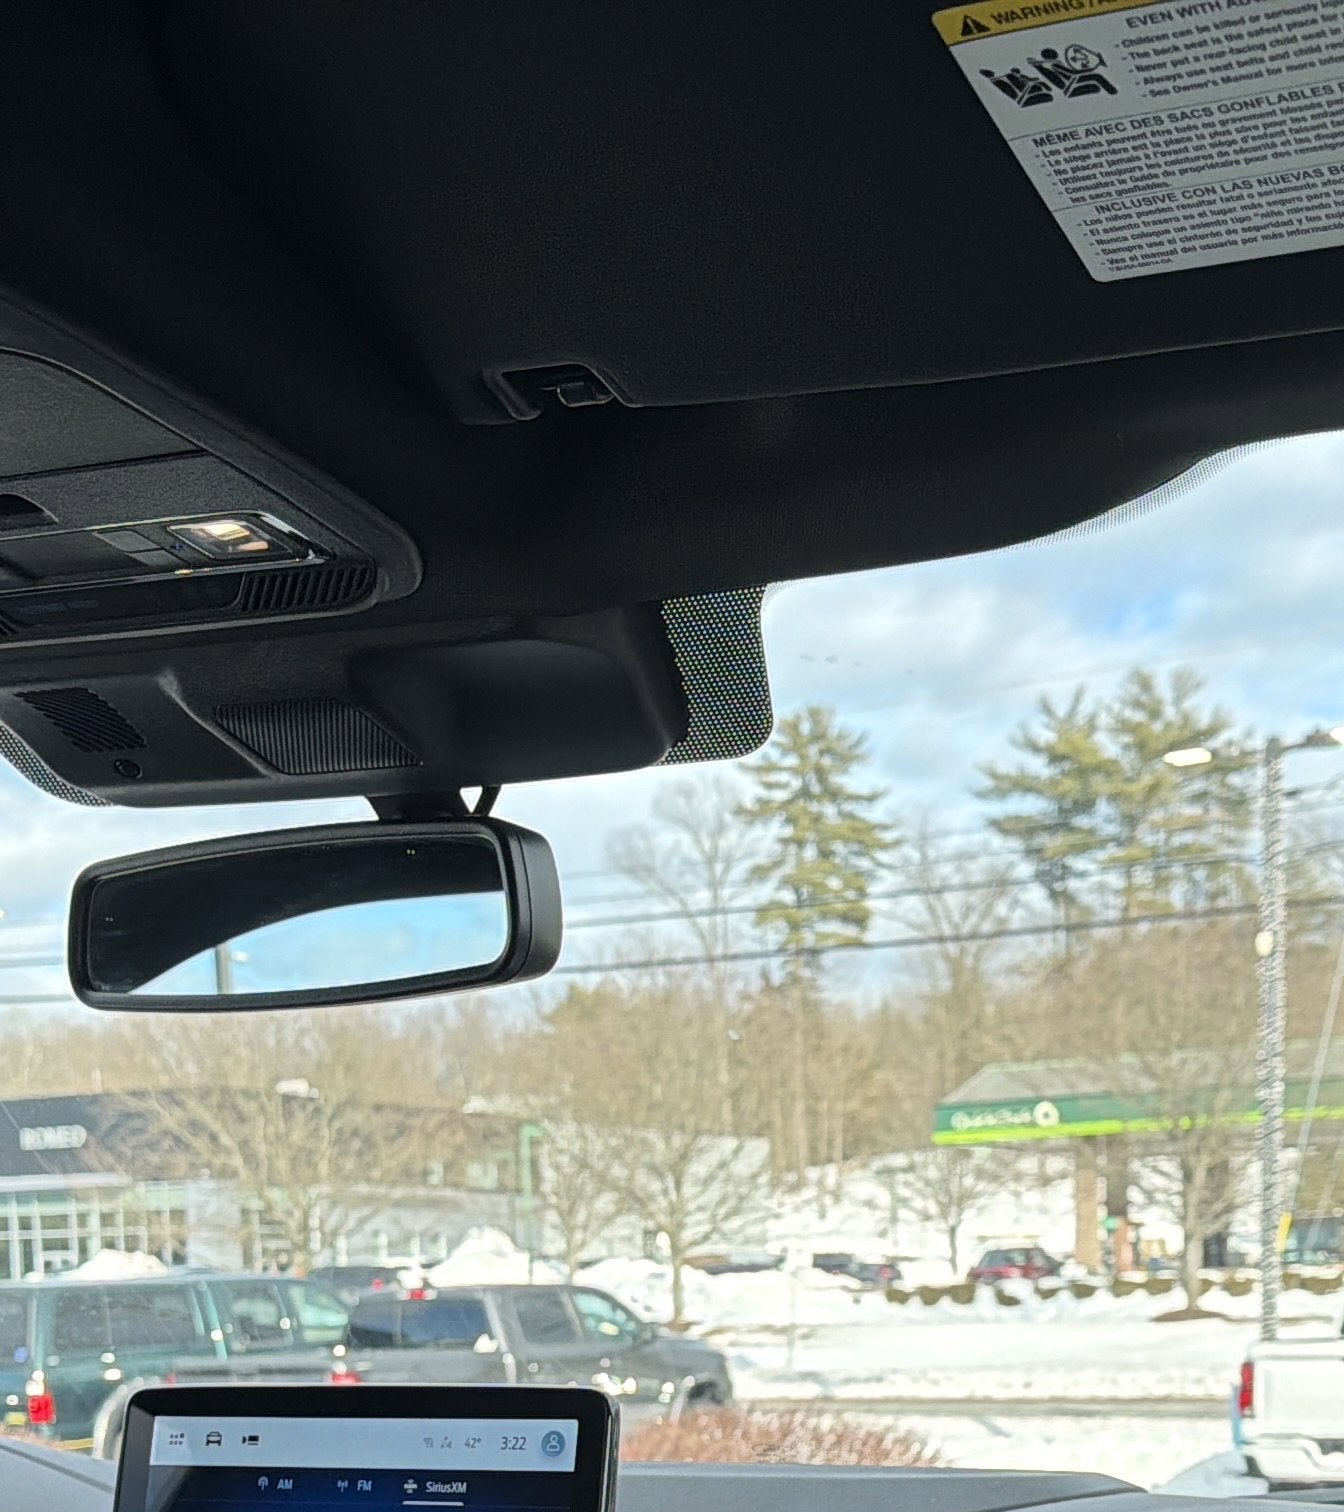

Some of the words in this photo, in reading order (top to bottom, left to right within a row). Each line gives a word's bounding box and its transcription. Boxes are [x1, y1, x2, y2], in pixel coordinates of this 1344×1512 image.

[991, 0, 1085, 25] WARNING
[1126, 10, 1175, 29] EVEN
[1032, 130, 1082, 147] MÊME
[1084, 122, 1127, 138] AVEC
[1129, 115, 1164, 130] DES
[1166, 106, 1214, 123] SACS
[1181, 186, 1217, 199] CON
[1219, 179, 1253, 193] LAS
[1256, 168, 1324, 187] NUEVAS
[500, 1436, 527, 1450] 3:22
[277, 1478, 293, 1490] AM
[356, 1480, 372, 1492] FM
[426, 1481, 467, 1494] SiriusXM
